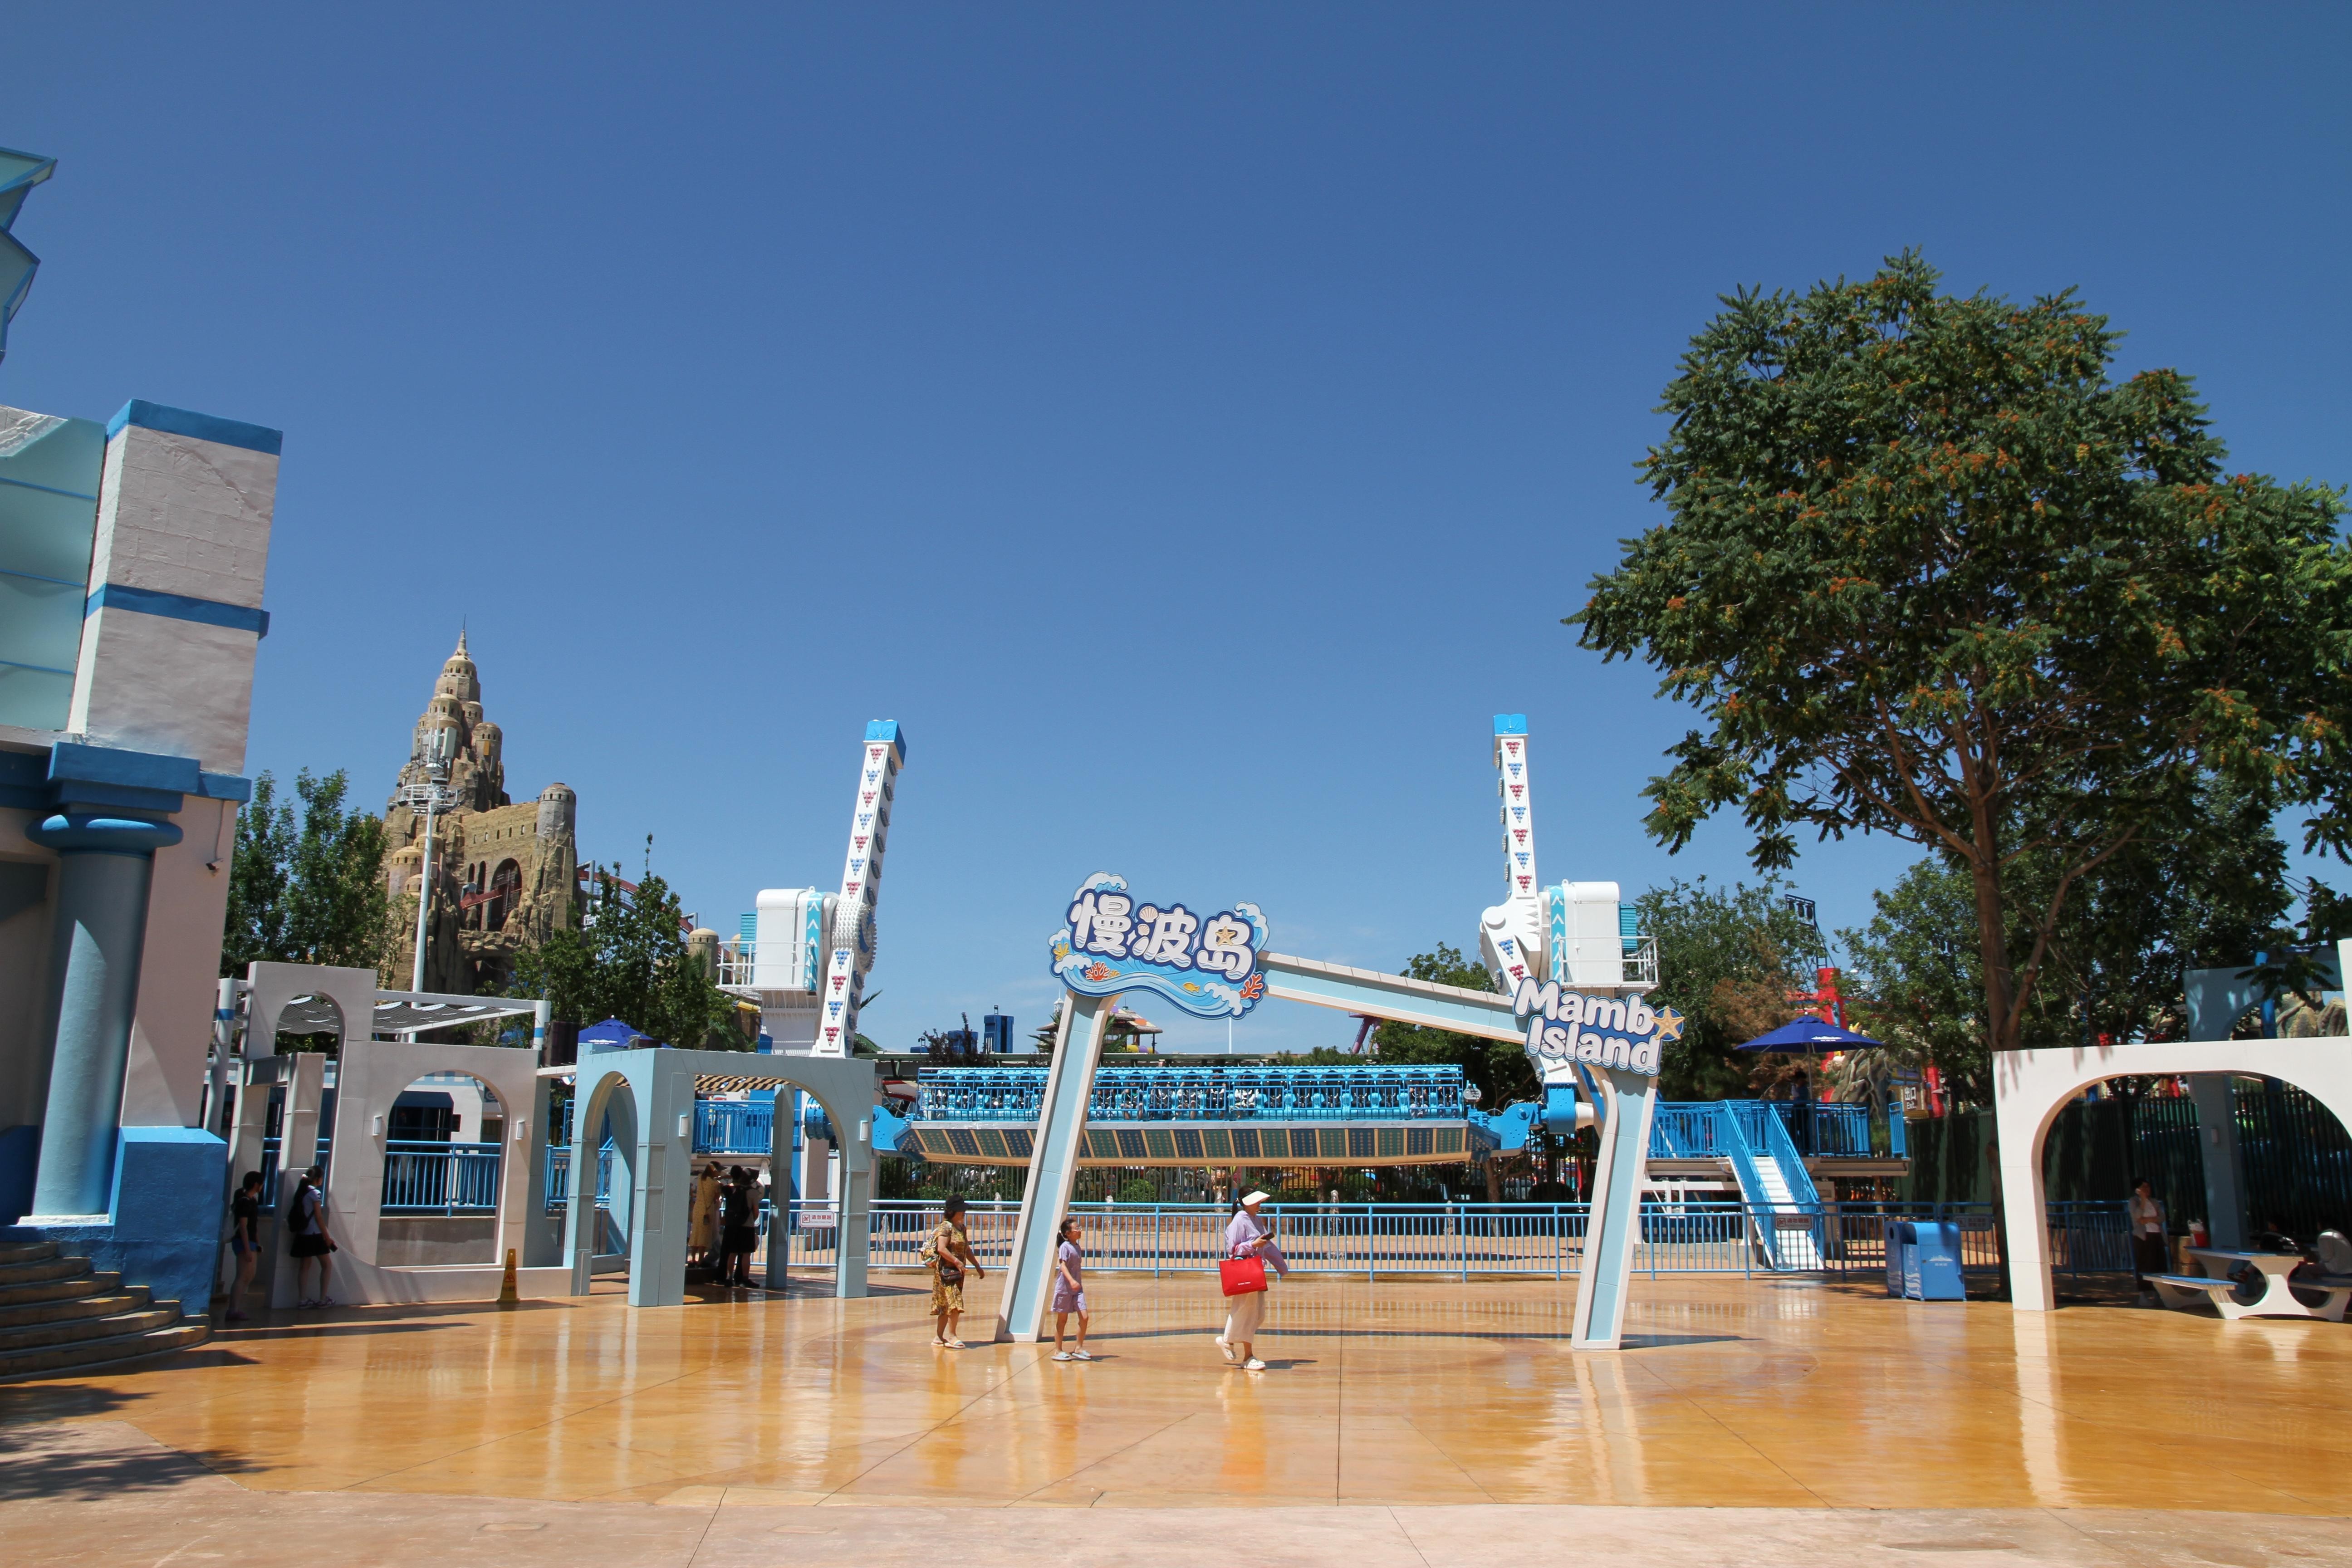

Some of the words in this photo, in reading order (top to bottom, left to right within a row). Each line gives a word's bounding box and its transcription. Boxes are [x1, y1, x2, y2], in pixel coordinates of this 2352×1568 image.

[1070, 892, 1253, 980] 慢波岛
[1528, 1016, 1661, 1075] Island
[1905, 1087, 1916, 1101] 出口
